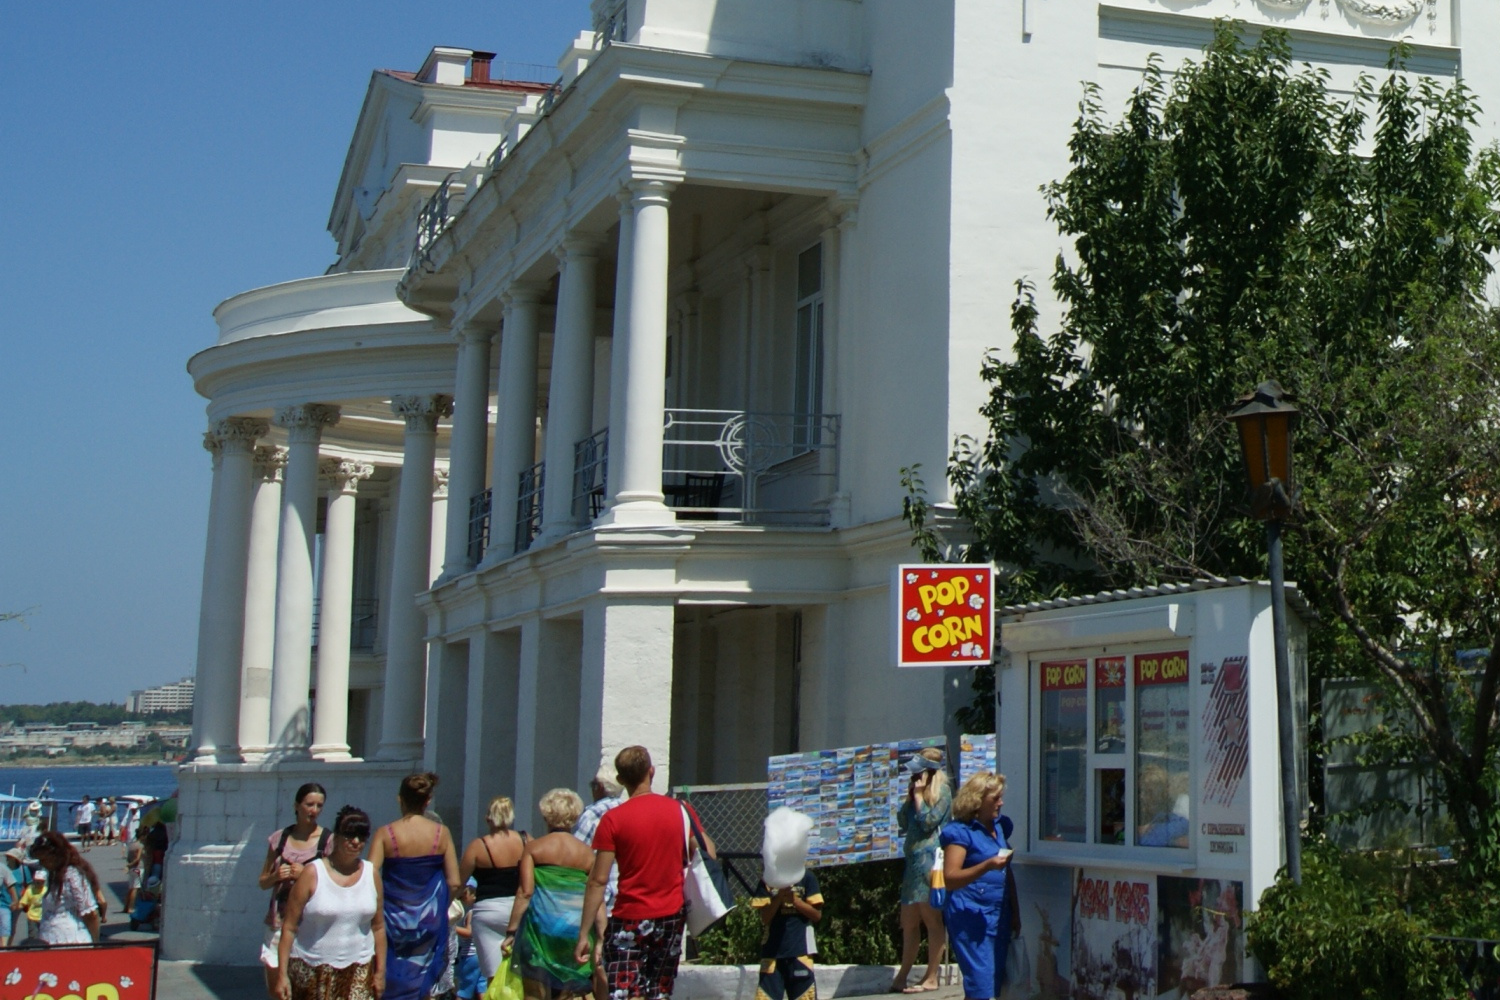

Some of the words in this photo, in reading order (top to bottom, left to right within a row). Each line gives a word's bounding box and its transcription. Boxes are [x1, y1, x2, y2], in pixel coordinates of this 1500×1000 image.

[918, 576, 970, 614] POP
[912, 614, 983, 654] CORN
[1046, 667, 1061, 687] POP
[1063, 664, 1086, 685] CORN
[1140, 659, 1159, 681] POP
[1161, 656, 1188, 679] CORN
